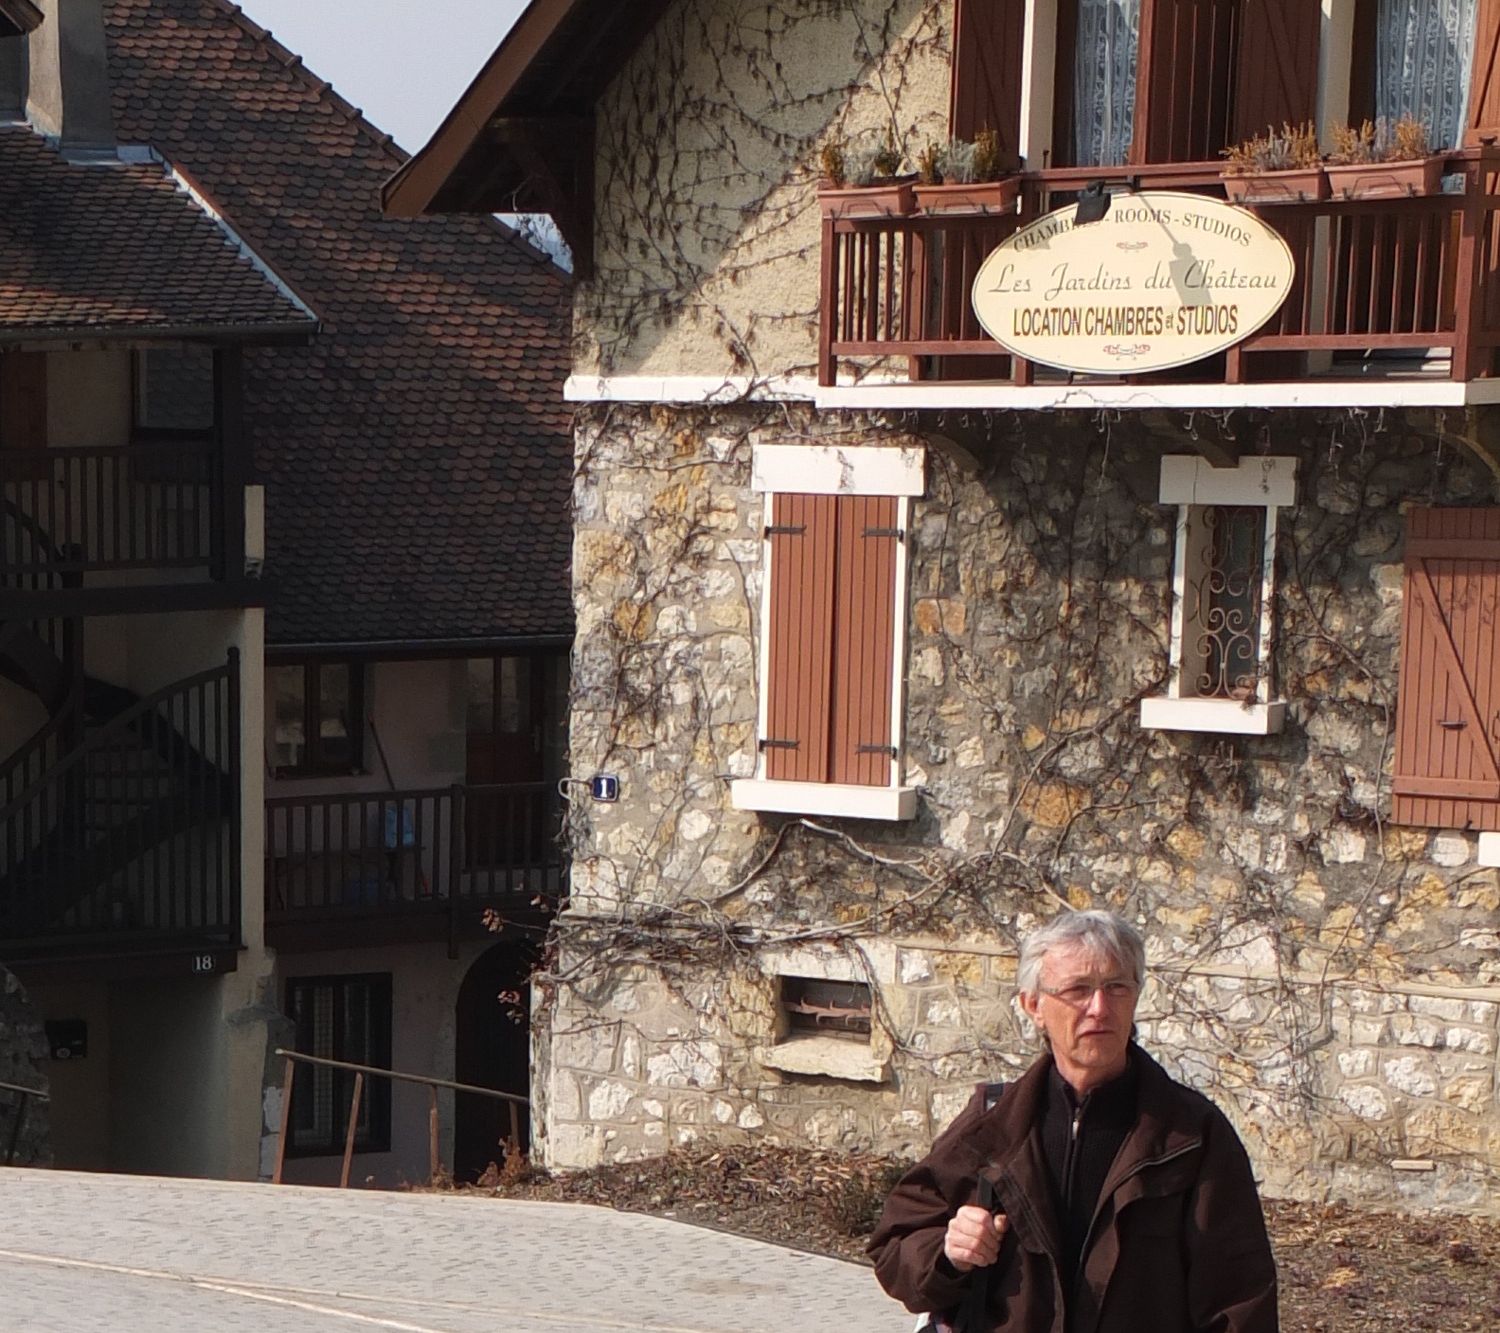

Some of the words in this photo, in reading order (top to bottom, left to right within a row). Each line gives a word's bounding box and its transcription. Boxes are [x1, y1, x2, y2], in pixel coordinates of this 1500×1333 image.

[1013, 217, 1100, 253] CHAMB
[1115, 208, 1171, 225] ROOMS
[1182, 212, 1252, 247] STUDIOS
[989, 264, 1031, 293] Les
[1044, 261, 1132, 302] Jardins
[1144, 261, 1173, 289] du
[1184, 260, 1278, 289] Château
[1013, 308, 1082, 337] LOCATION
[1085, 306, 1164, 336] CHAMBRES
[1176, 304, 1238, 336] STUDIOS
[600, 778, 607, 798] 1
[195, 955, 212, 971] 18
